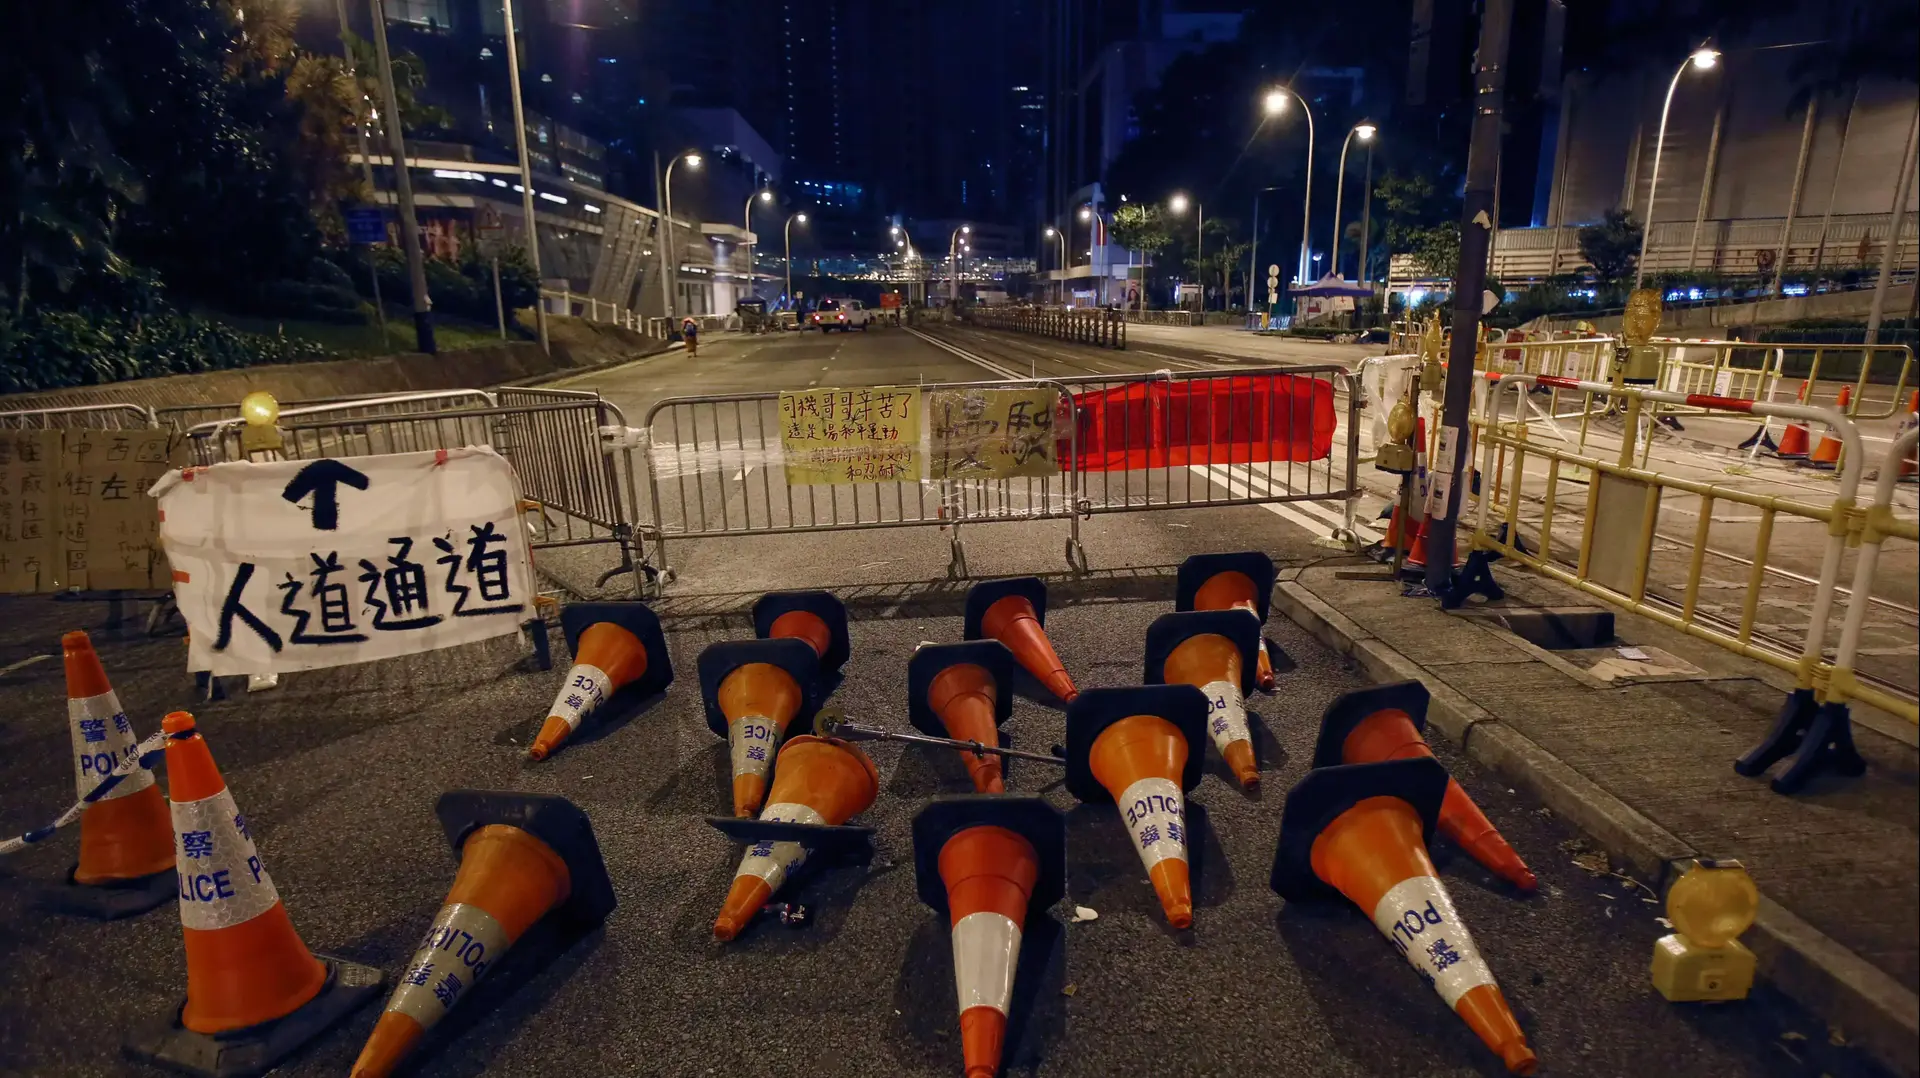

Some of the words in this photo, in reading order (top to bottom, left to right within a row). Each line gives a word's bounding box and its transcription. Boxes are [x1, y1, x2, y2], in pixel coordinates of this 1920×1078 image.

[782, 390, 912, 421] 司機哥哥辛苦了
[787, 422, 899, 441] 這是場和平運動
[846, 462, 895, 481] 和忍耐
[212, 521, 525, 652] 人道通道
[80, 712, 131, 743] 警察
[179, 869, 235, 902] LICE
